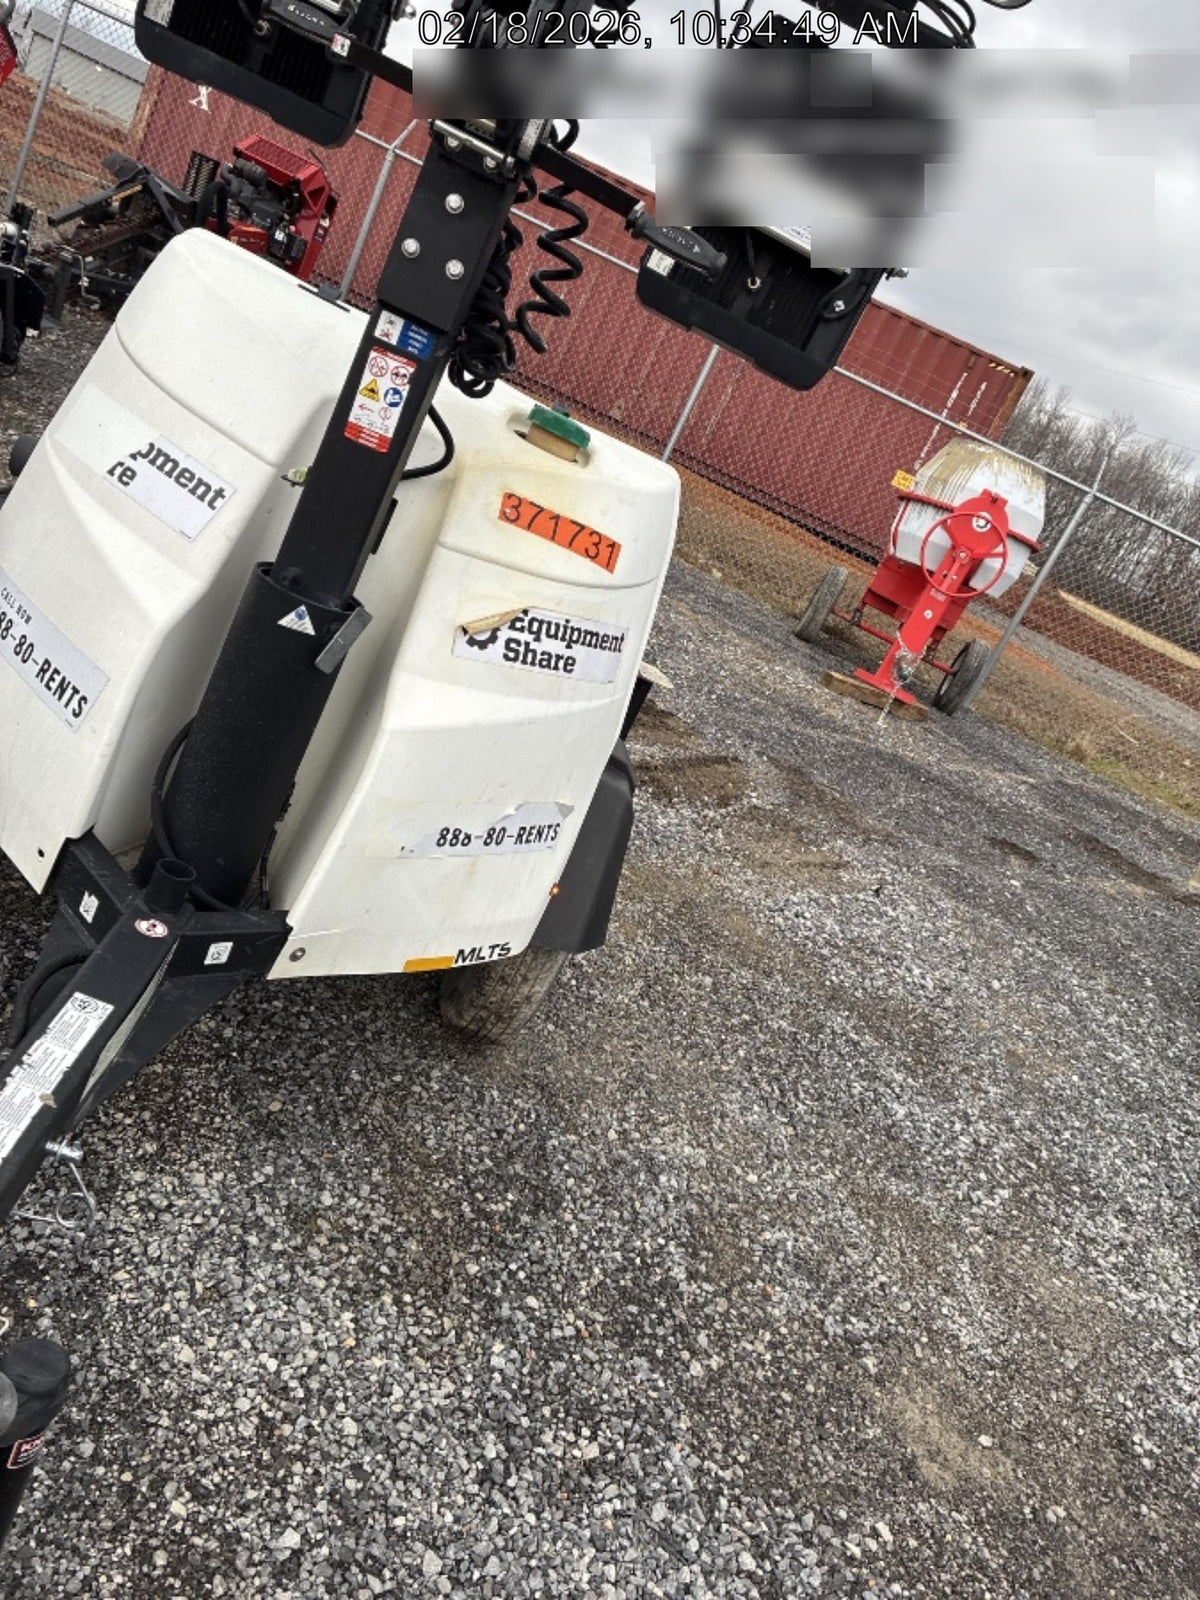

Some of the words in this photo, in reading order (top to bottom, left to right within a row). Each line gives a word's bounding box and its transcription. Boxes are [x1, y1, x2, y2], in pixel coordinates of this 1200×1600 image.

[503, 492, 617, 569] 371731
[508, 608, 625, 653] Equipment
[503, 638, 577, 674] Share
[454, 942, 512, 964] MLTS
